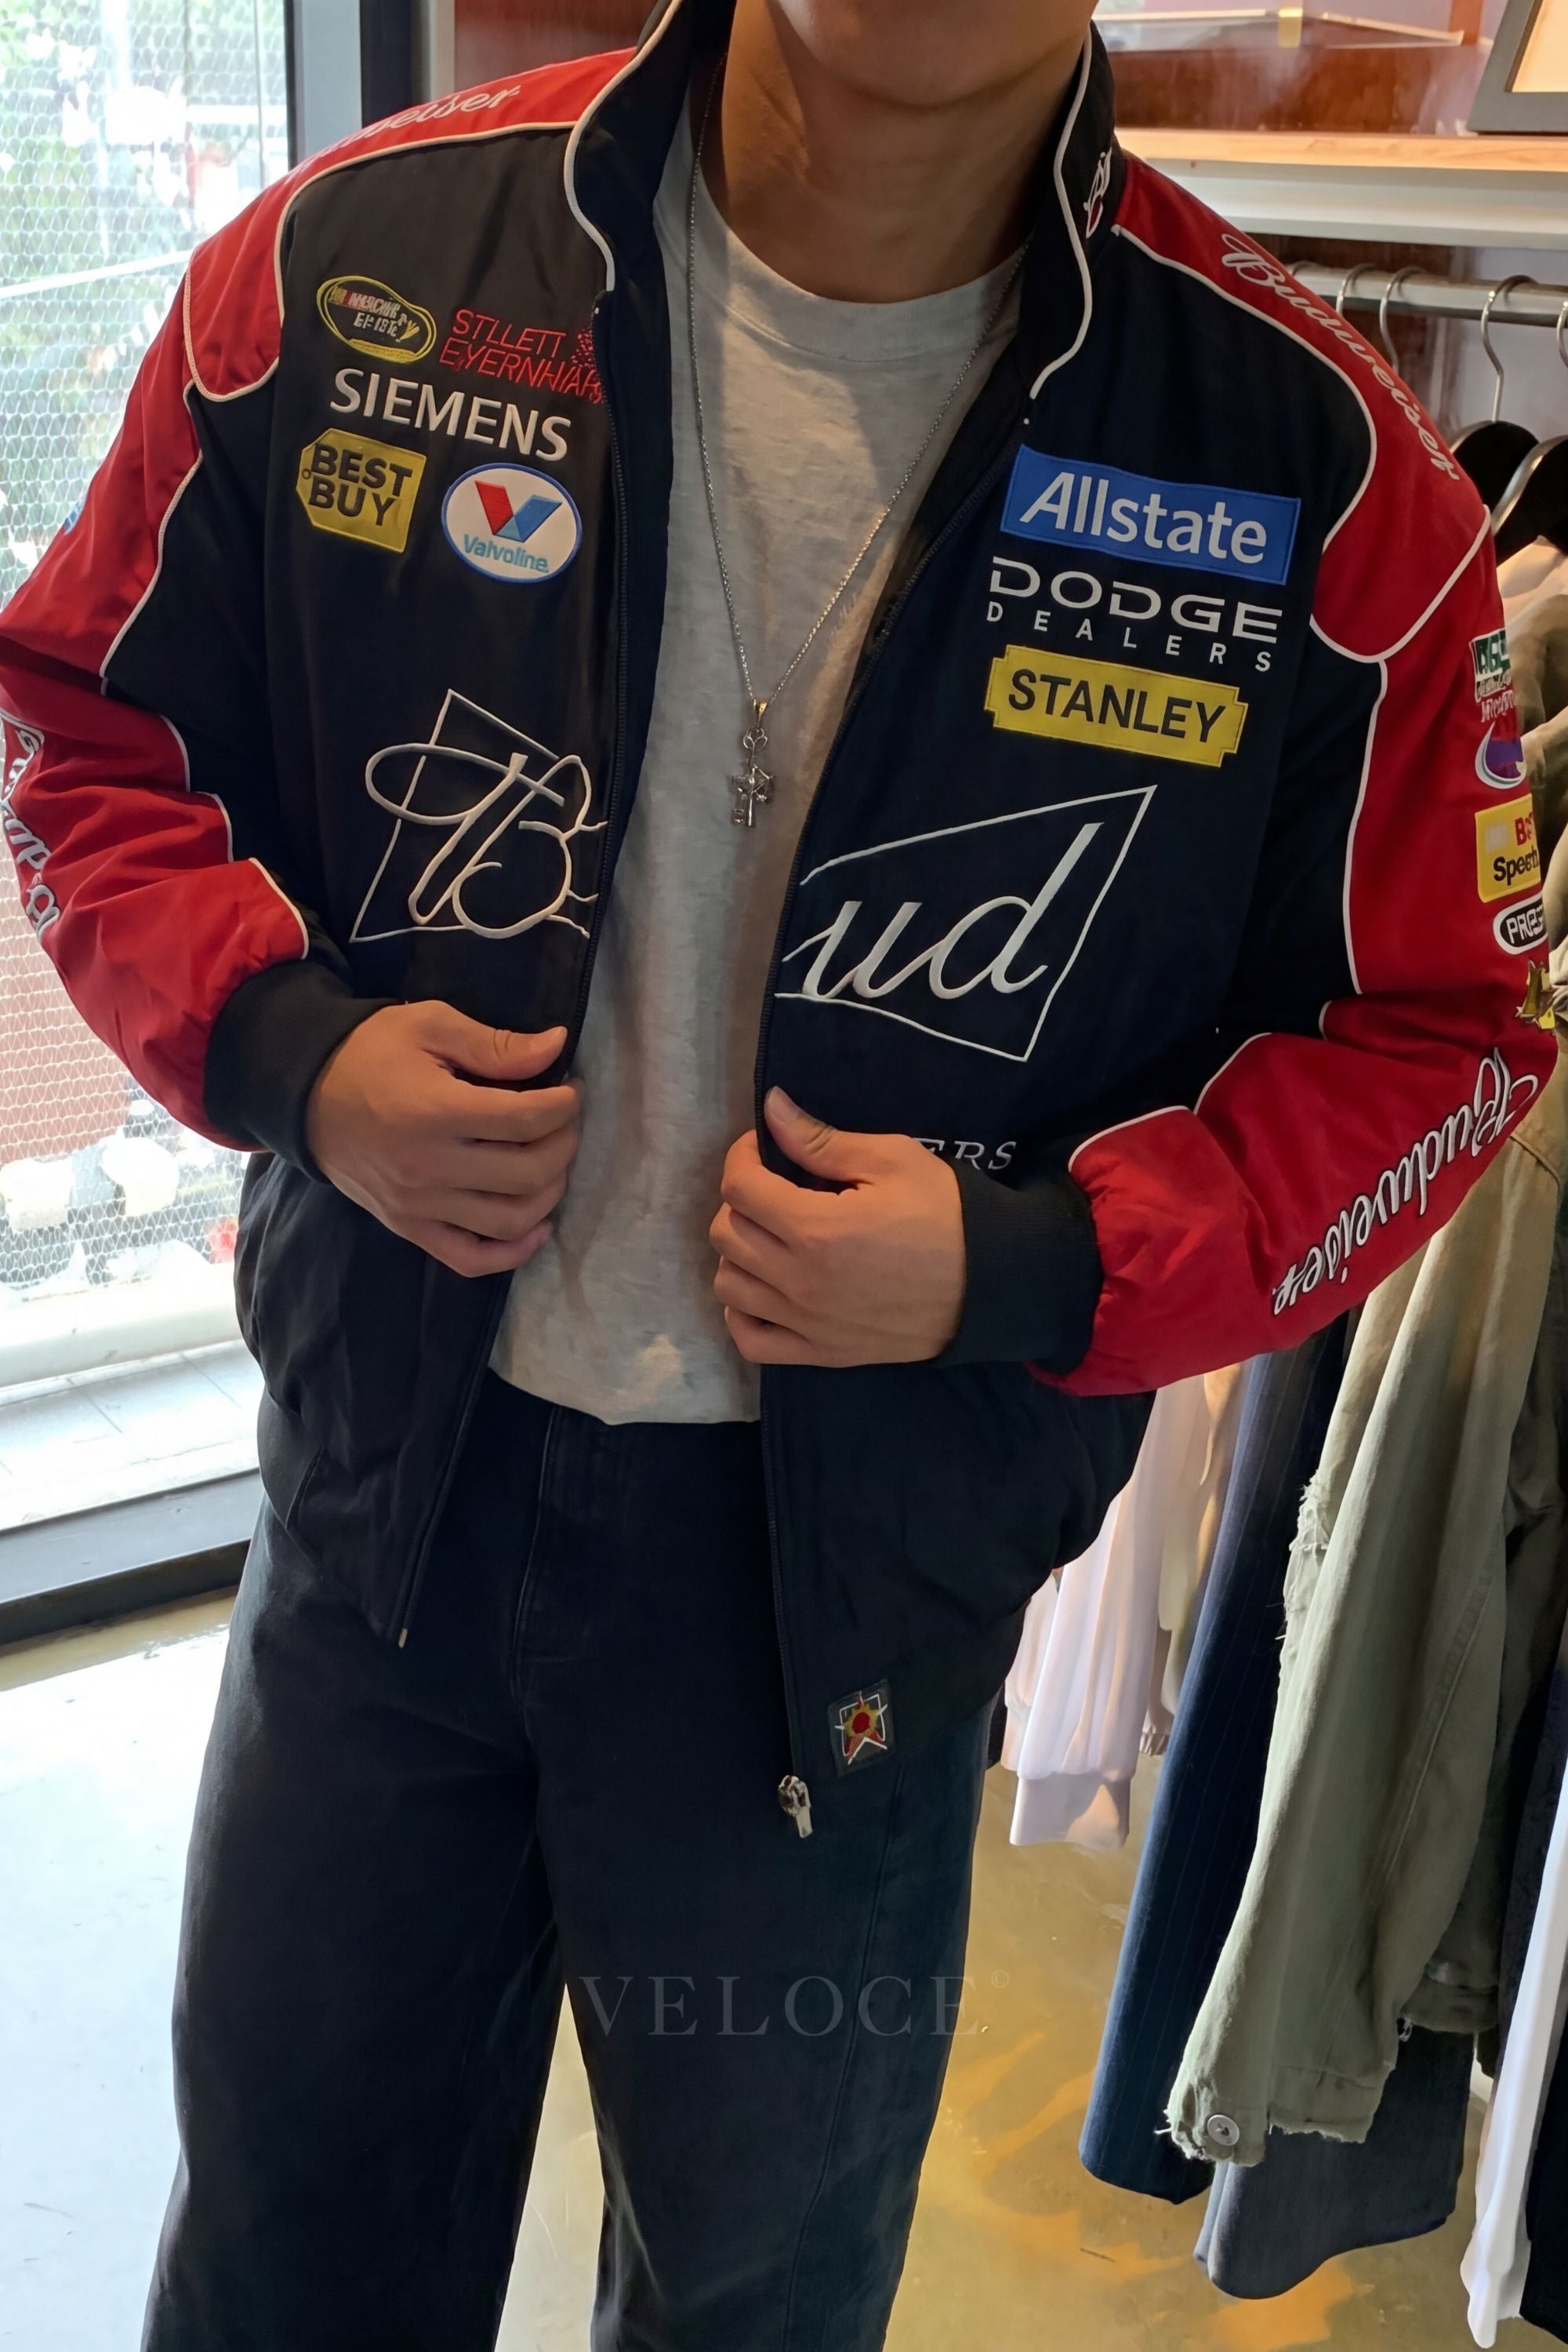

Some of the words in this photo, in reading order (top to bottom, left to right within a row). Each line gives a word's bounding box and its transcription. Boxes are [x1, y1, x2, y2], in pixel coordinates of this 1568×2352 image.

[330, 368, 572, 462] SIEMENS
[308, 475, 396, 527] BUY
[310, 442, 414, 497] BEST
[463, 533, 550, 574] Valvoline
[1019, 471, 1268, 564] Allstate
[986, 600, 1272, 673] DEALERS
[989, 556, 1283, 644] DODGE
[1007, 667, 1226, 744] STANLEY
[1272, 1046, 1539, 1316] Budweiser
